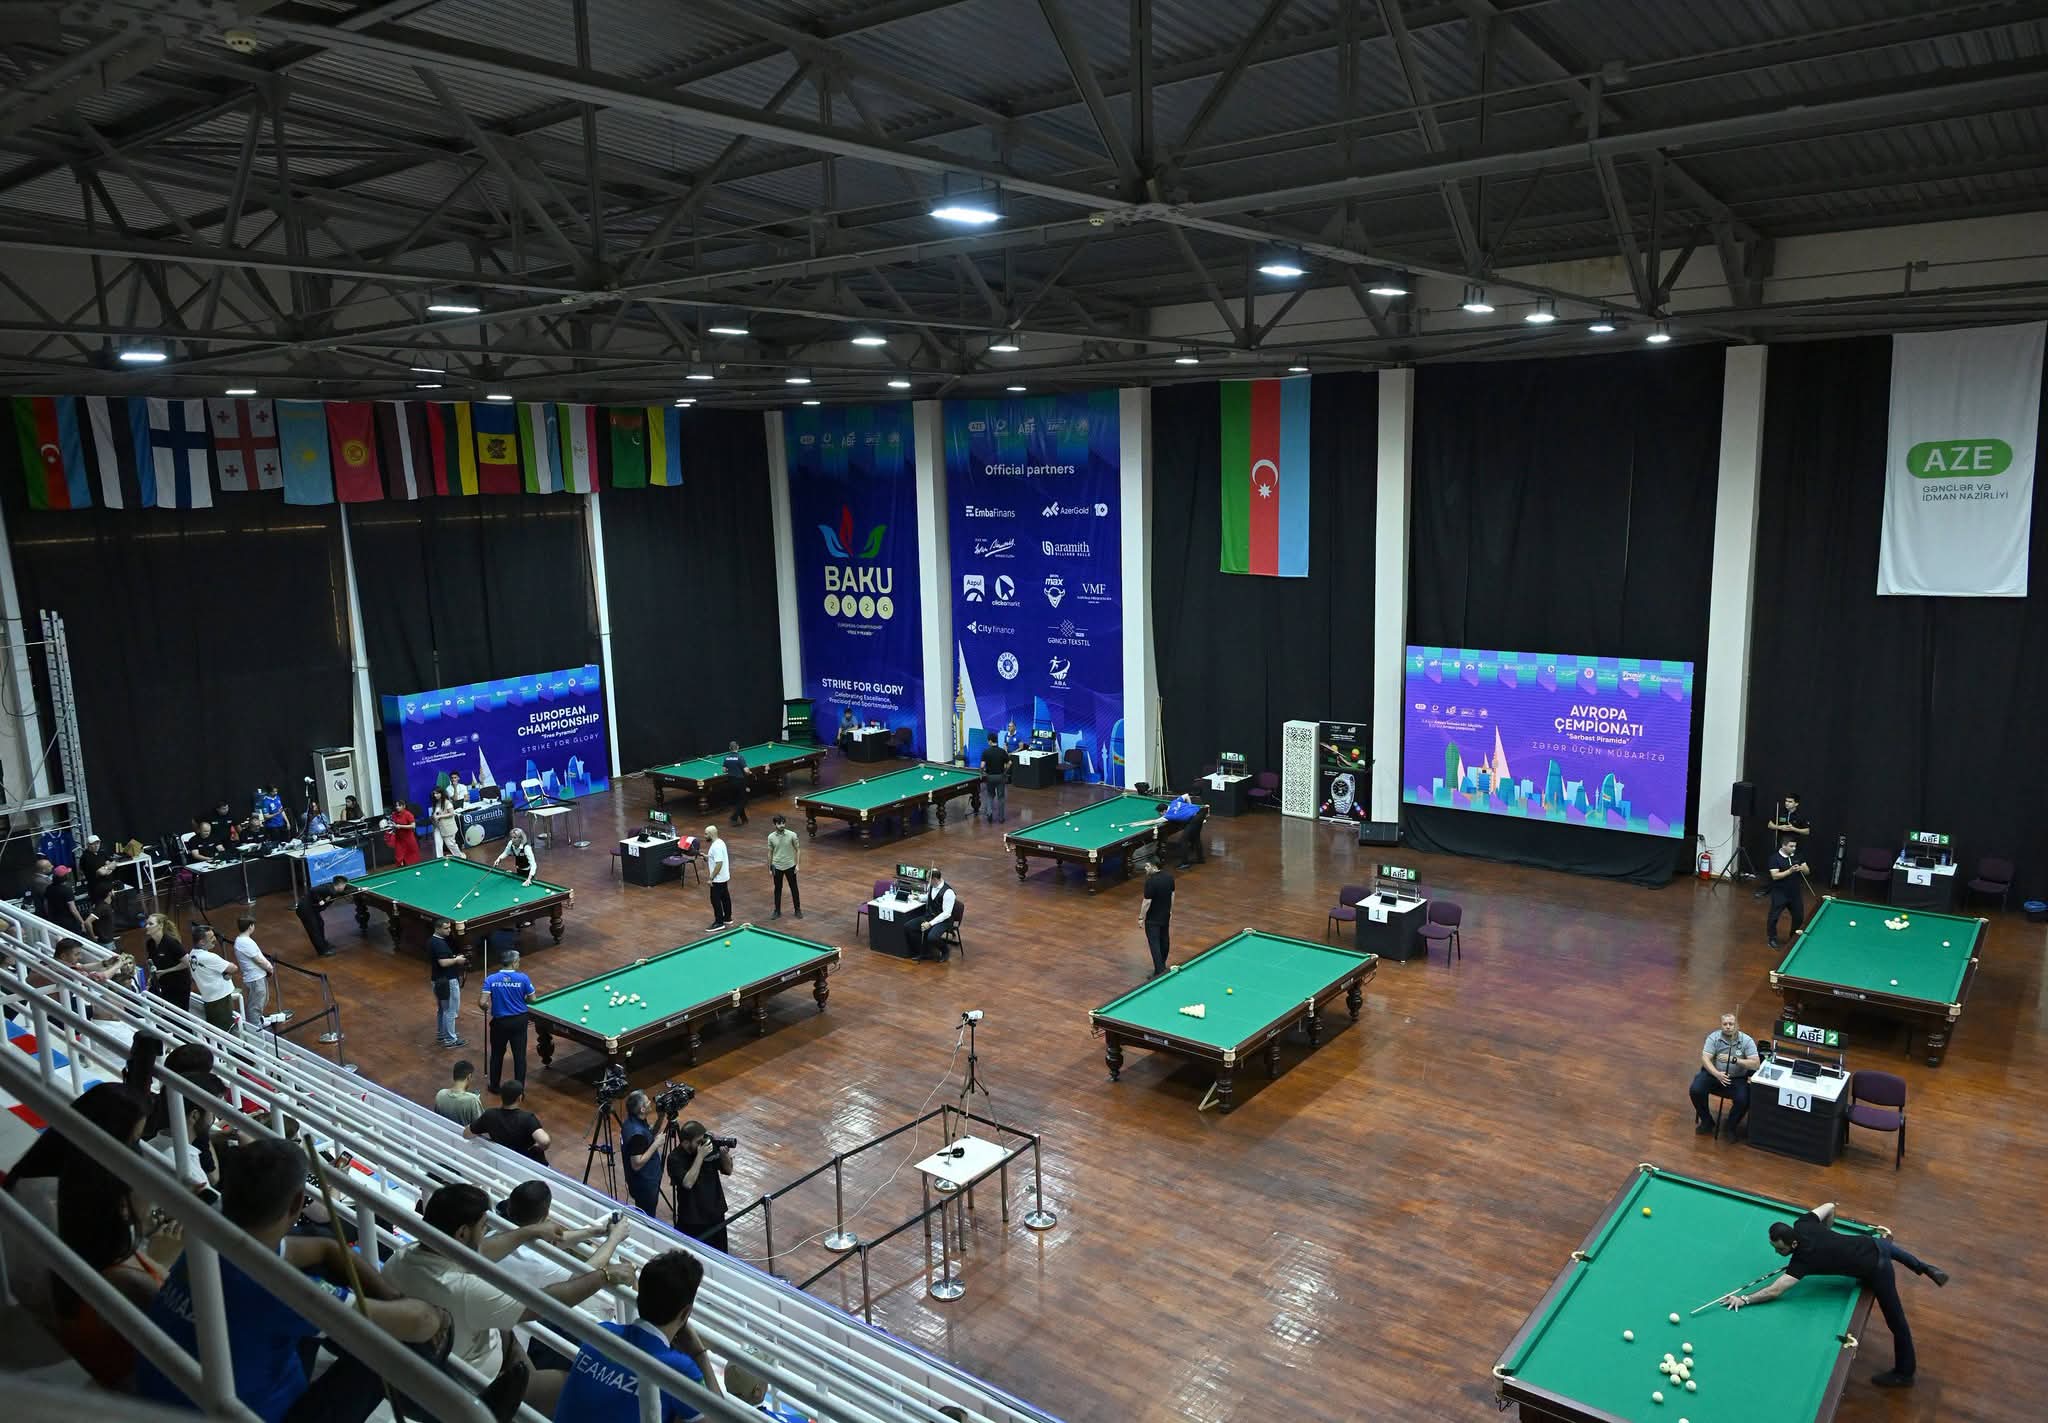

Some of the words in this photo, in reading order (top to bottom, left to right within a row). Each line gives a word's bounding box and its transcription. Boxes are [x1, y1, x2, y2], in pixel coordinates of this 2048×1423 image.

[1923, 445, 1993, 472] AZE
[985, 464, 1025, 476] Official
[1026, 464, 1075, 477] partners
[974, 508, 1016, 518] EmbaFinans
[1060, 507, 1089, 515] AzerGold
[1054, 541, 1090, 553] aramith
[824, 565, 893, 594] BAKU
[1082, 583, 1107, 595] VMF
[822, 678, 853, 690] STRIKE
[853, 681, 872, 692] FOR
[873, 683, 904, 696] GLORY
[834, 691, 864, 701] Celebrating
[861, 701, 899, 711] Sportsmanship
[1570, 704, 1628, 721] AVROPA
[529, 705, 586, 723] EUROPEAN
[517, 713, 600, 737] CHAMPIONSHIP
[1554, 716, 1643, 737] ÇEMPİONATI
[521, 742, 552, 754] STRIKE
[554, 738, 570, 747] FOR
[573, 733, 600, 744] GLORY
[474, 808, 503, 822] aramith
[1916, 874, 1924, 884] 5
[1375, 909, 1381, 920] 1
[1799, 1030, 1823, 1042] ABF
[1786, 1093, 1808, 1110] 10
